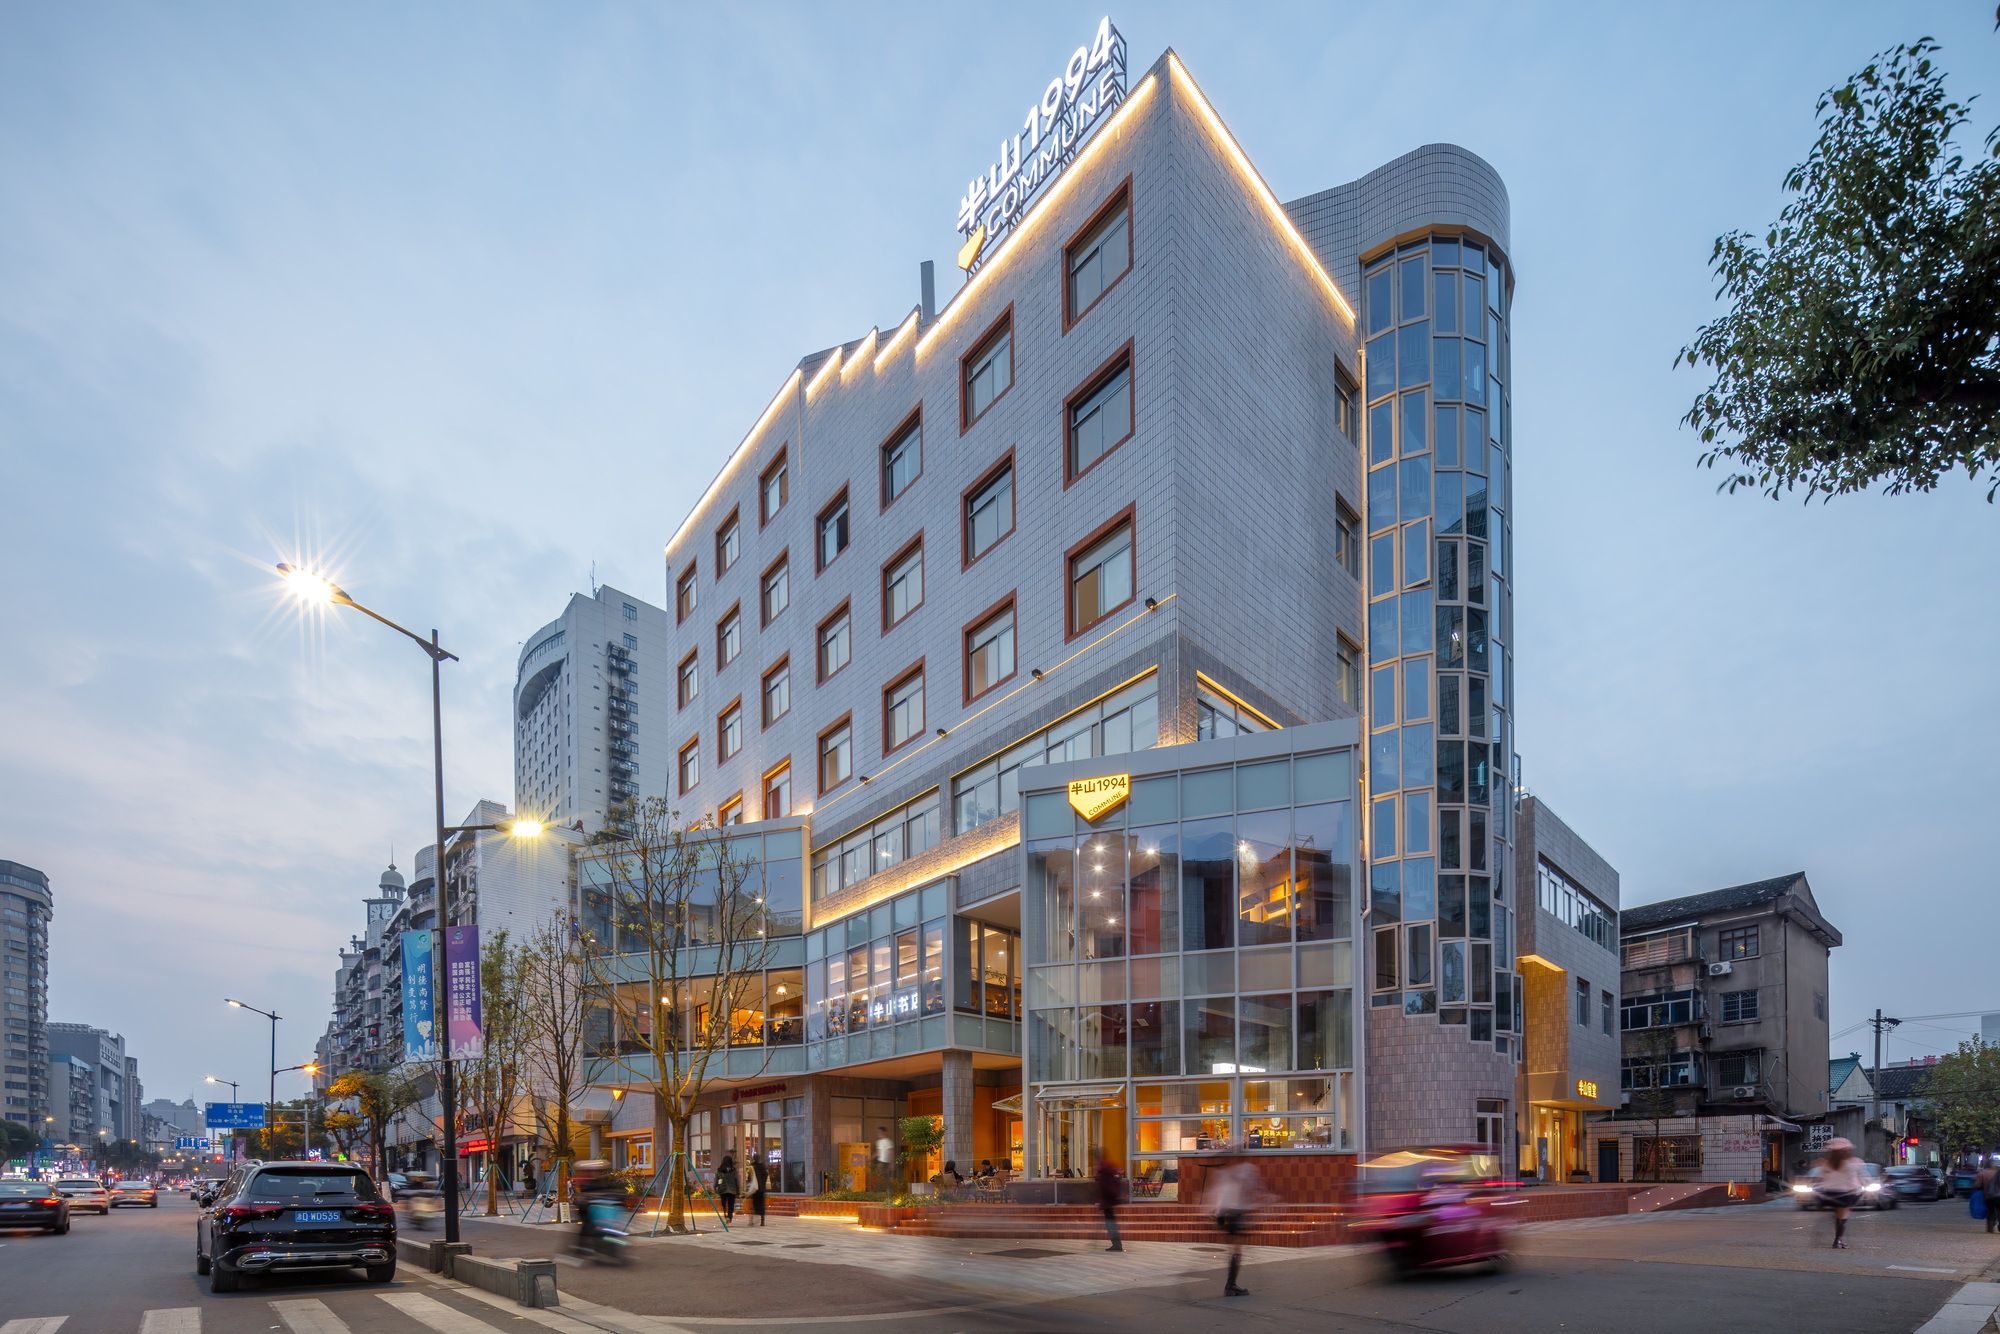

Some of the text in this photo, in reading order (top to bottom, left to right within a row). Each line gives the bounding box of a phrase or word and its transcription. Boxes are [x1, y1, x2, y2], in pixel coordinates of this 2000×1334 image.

[957, 15, 1116, 232] 半山1994
[987, 68, 1116, 238] COMMUNE
[1071, 777, 1126, 795] 半山1994
[1089, 791, 1123, 816] COMMUNE
